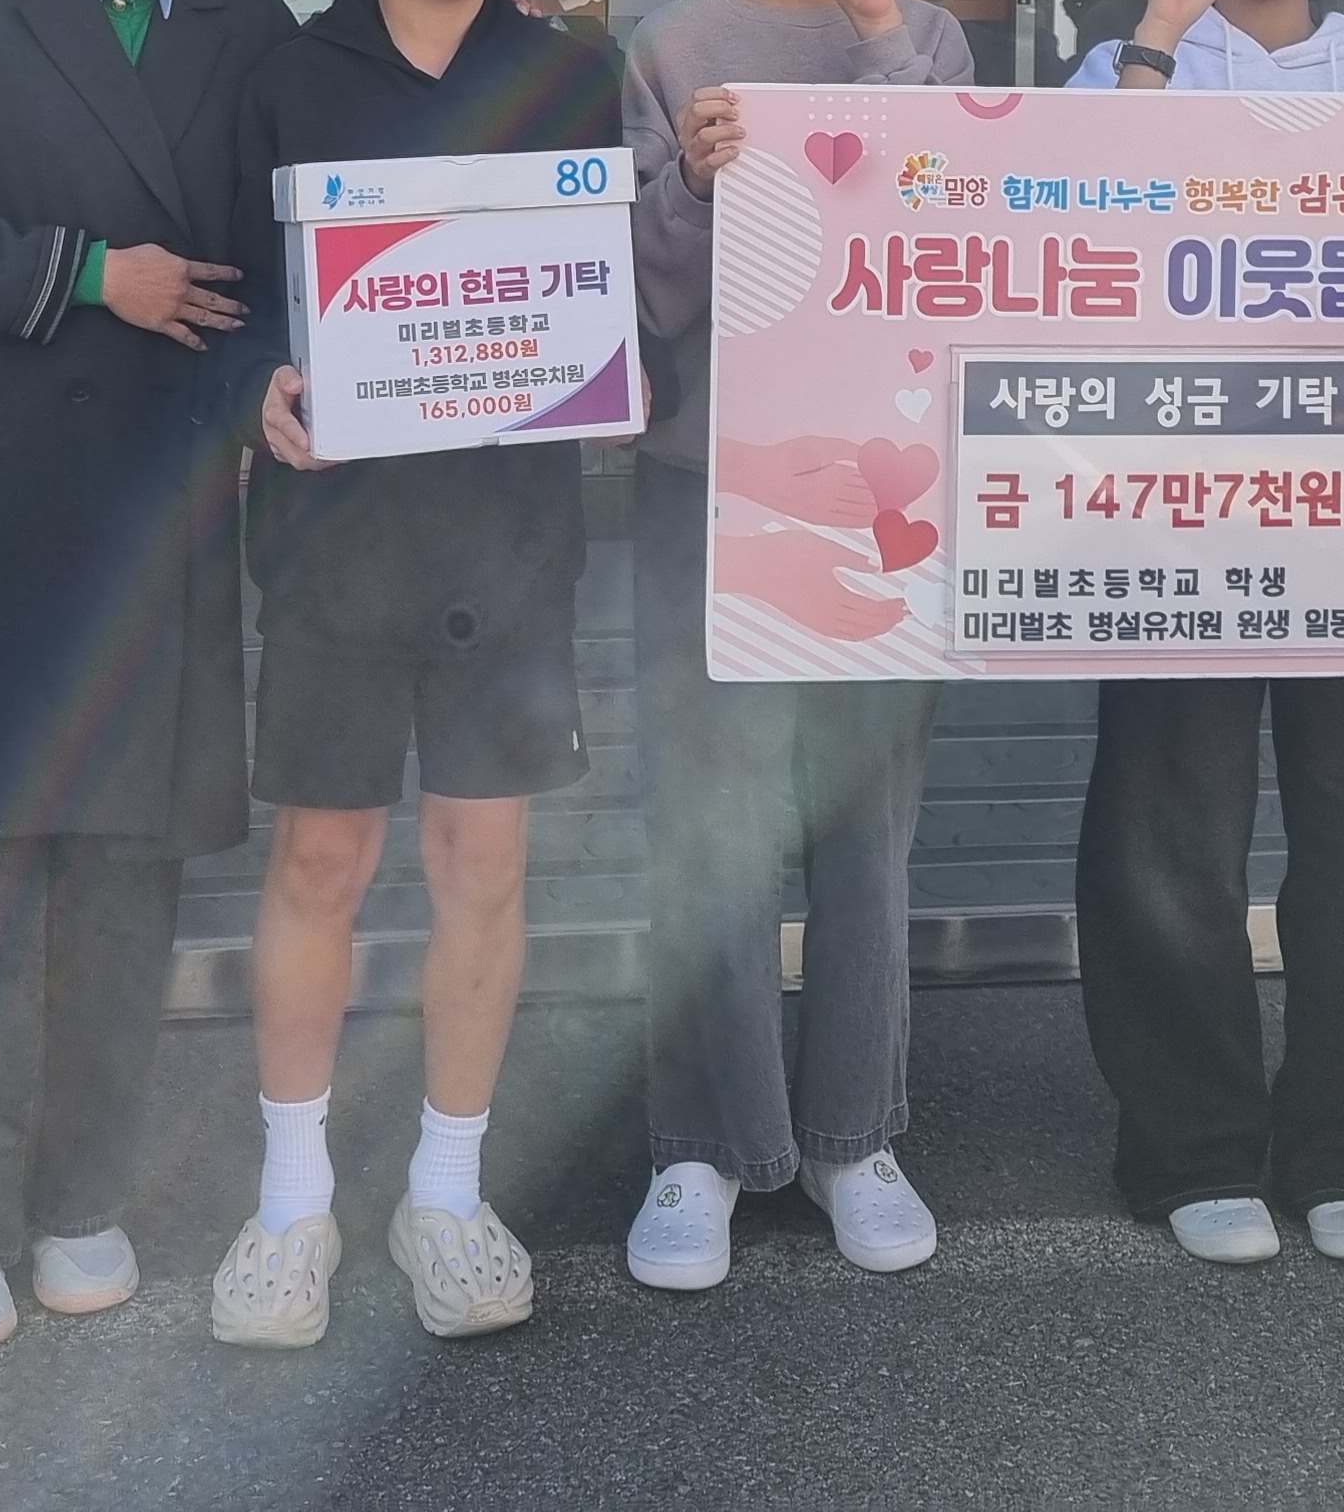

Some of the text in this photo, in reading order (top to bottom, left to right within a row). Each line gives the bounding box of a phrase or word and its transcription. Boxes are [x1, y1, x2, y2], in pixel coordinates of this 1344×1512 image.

[556, 158, 608, 196] 80
[944, 177, 988, 206] 밀양
[1002, 176, 1069, 211] 함께
[1079, 179, 1178, 211] 나누는
[1184, 178, 1281, 213] 행복한
[343, 260, 610, 312] 사랑의 현금 기탁
[830, 235, 1139, 318] 사랑나눔
[398, 313, 550, 343] 미리벌초등학교
[412, 339, 539, 367] 1,312,880원
[356, 364, 585, 400] 미리벌초등학교 병설유치원
[419, 393, 533, 420] 165,000원
[990, 376, 1338, 428] 사랑의 성금 기탁
[977, 470, 1342, 529] 금 147만7천원
[962, 567, 1287, 599] 미리벌초등학교 학생
[963, 611, 1073, 642] 미리벌초
[1088, 610, 1223, 641] 병설유치원
[1237, 609, 1290, 639] 원생
